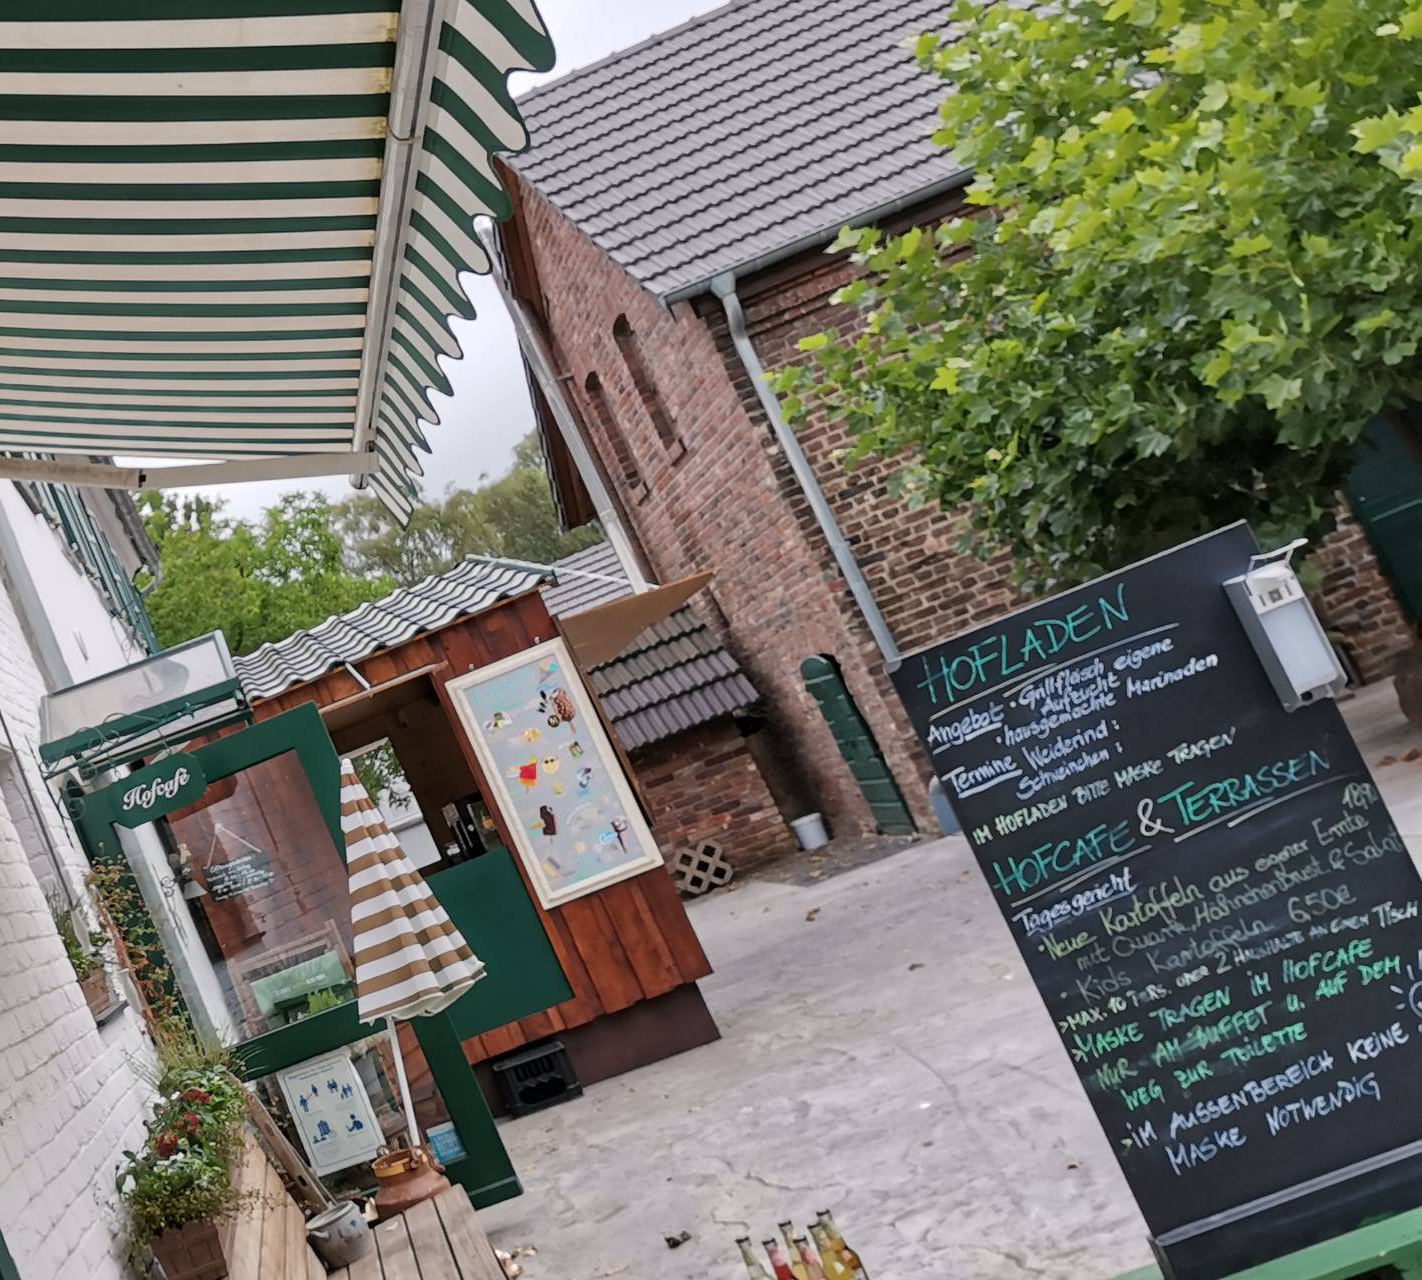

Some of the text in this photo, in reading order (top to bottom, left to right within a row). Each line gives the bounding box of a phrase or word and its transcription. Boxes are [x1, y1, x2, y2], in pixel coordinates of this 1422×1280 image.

[916, 581, 1130, 704] HOFLADEN
[928, 701, 1005, 748] Angebot
[1113, 637, 1175, 670] eigene
[1003, 653, 1219, 748] hausgemachte Marinaden
[940, 755, 1018, 794] Termine
[972, 726, 1237, 846] IM HOFLADEN BITTE MASKE TRAGEN
[992, 750, 1331, 896] HOFCAFE & TERRASSEN
[1011, 865, 1140, 932] Tagesgericht
[1041, 809, 1371, 961] Neue Kartoffeln aus eigener Ernte
[1077, 941, 1112, 972] mit
[1343, 825, 1404, 866] Salat
[1075, 965, 1132, 1005] Kids
[1146, 918, 1275, 974] Kartoffeln
[1107, 996, 1127, 1014] 10
[1214, 951, 1233, 975] 2
[1148, 985, 1231, 1032] TRAGEN
[1281, 937, 1374, 984] HOFCAFE
[1095, 1057, 1139, 1091] NUR
[1151, 1037, 1184, 1068] AM
[1186, 1000, 1274, 1050] BUFFET
[1314, 969, 1348, 1001] AUF
[1357, 954, 1401, 986] DEM
[1120, 1078, 1166, 1112] WEG
[1172, 1059, 1214, 1090] ZUR
[1164, 1071, 1382, 1177] MASKE NOTWENDIG
[1169, 1049, 1334, 1140] AUSSENBEREICH
[1345, 1021, 1410, 1064] KEINE
